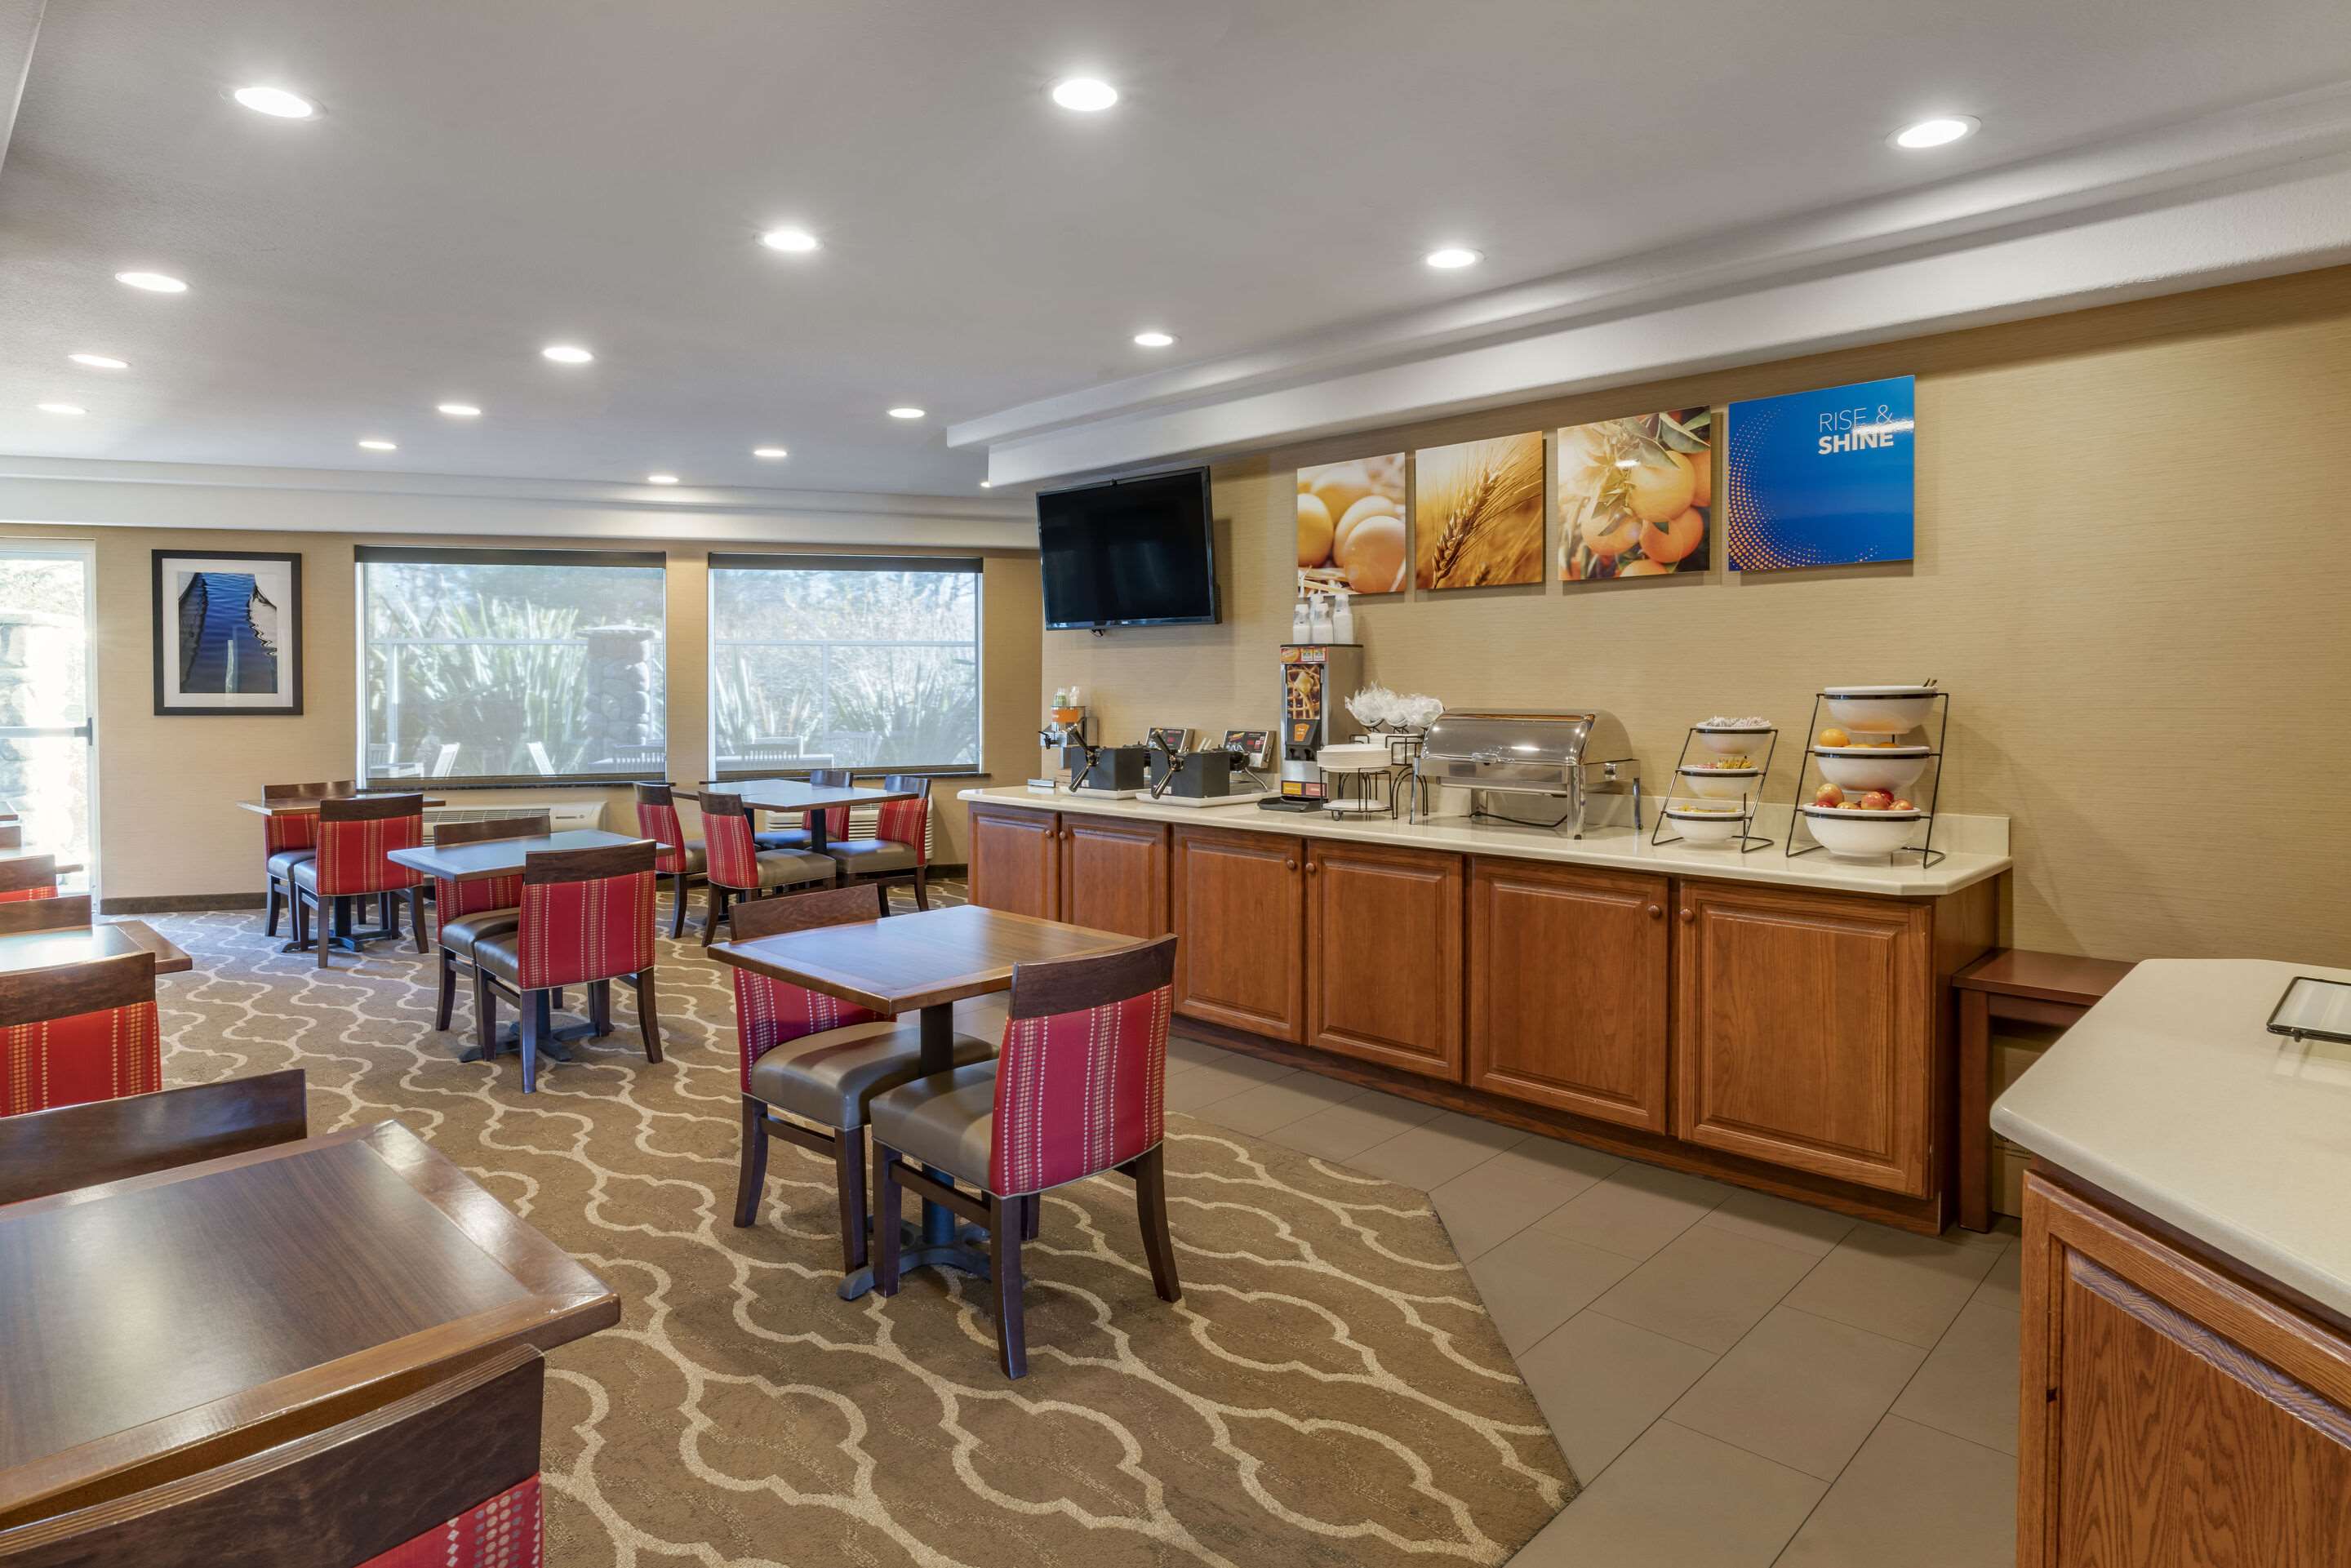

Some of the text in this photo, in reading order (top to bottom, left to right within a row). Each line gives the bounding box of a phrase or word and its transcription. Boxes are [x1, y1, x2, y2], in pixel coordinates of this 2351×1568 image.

[1820, 404, 1893, 433] RISE &
[1818, 430, 1895, 455] SHINE
